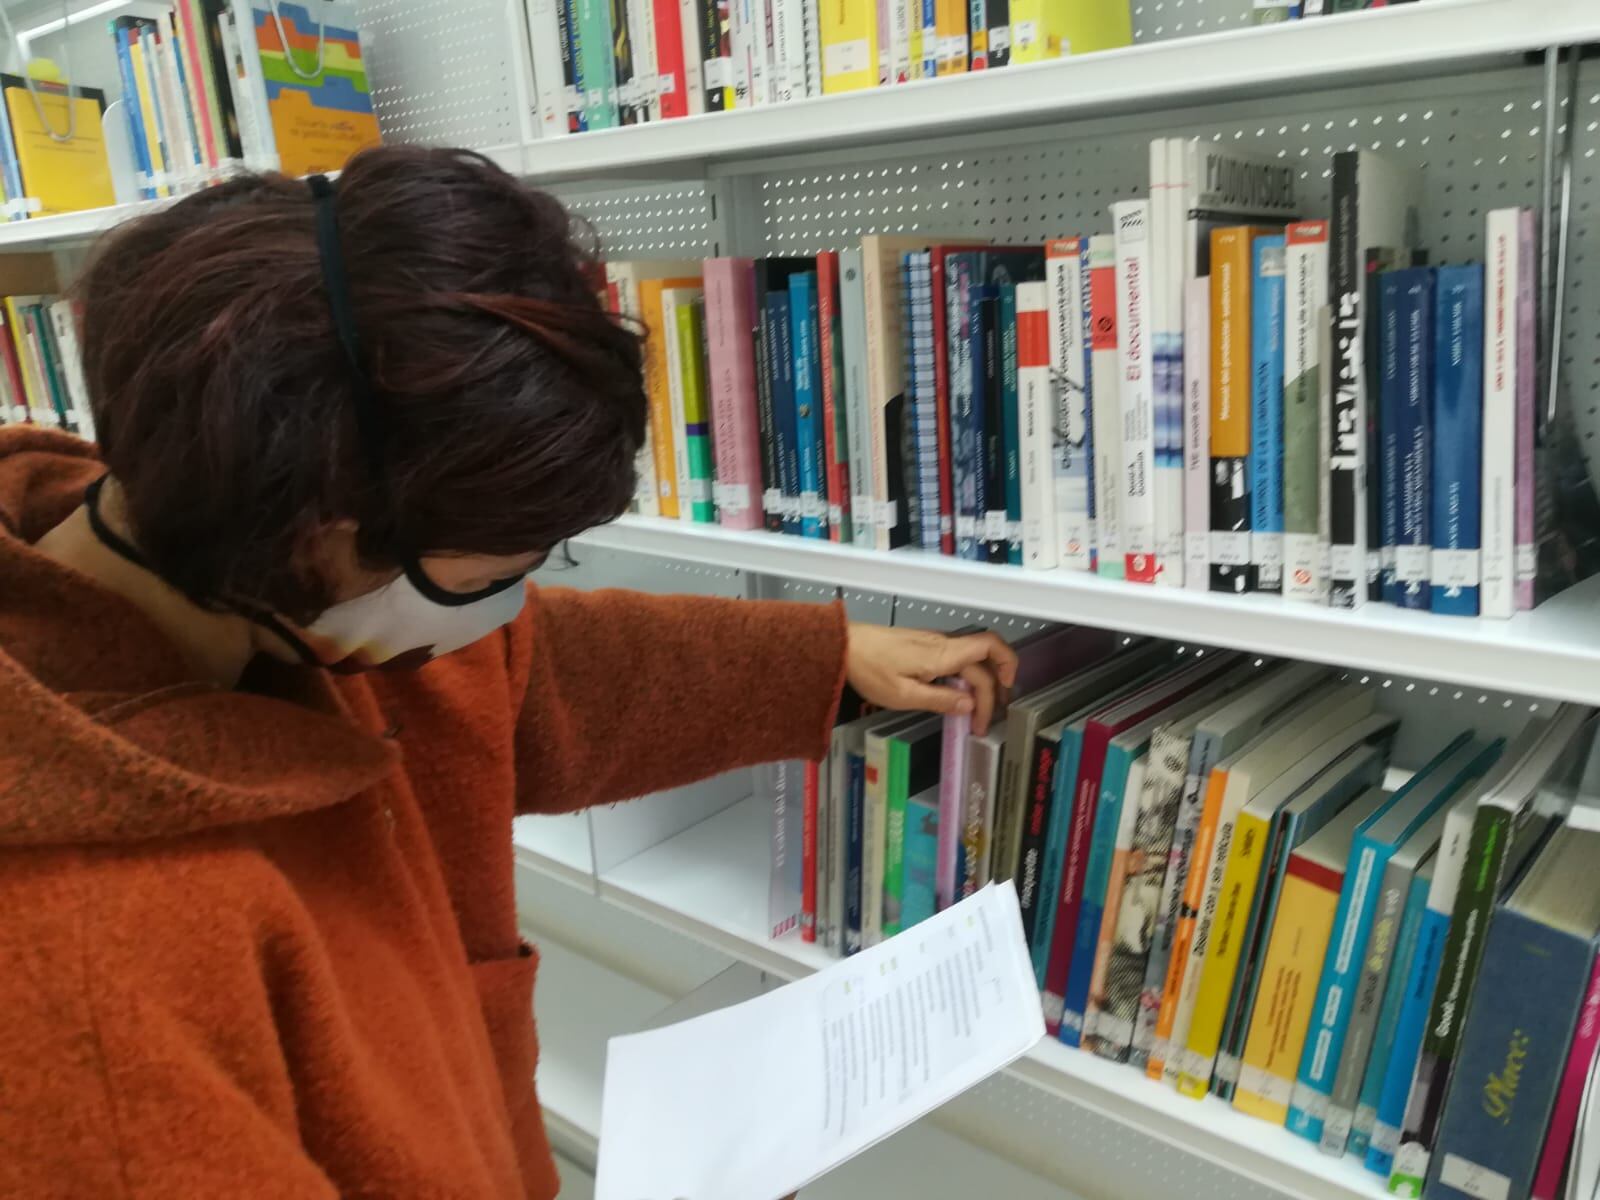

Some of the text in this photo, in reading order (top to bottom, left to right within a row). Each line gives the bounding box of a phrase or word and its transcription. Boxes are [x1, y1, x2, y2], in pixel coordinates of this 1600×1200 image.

[1123, 256, 1142, 361] documental
[1126, 364, 1142, 382] El
[1220, 368, 1231, 385] del
